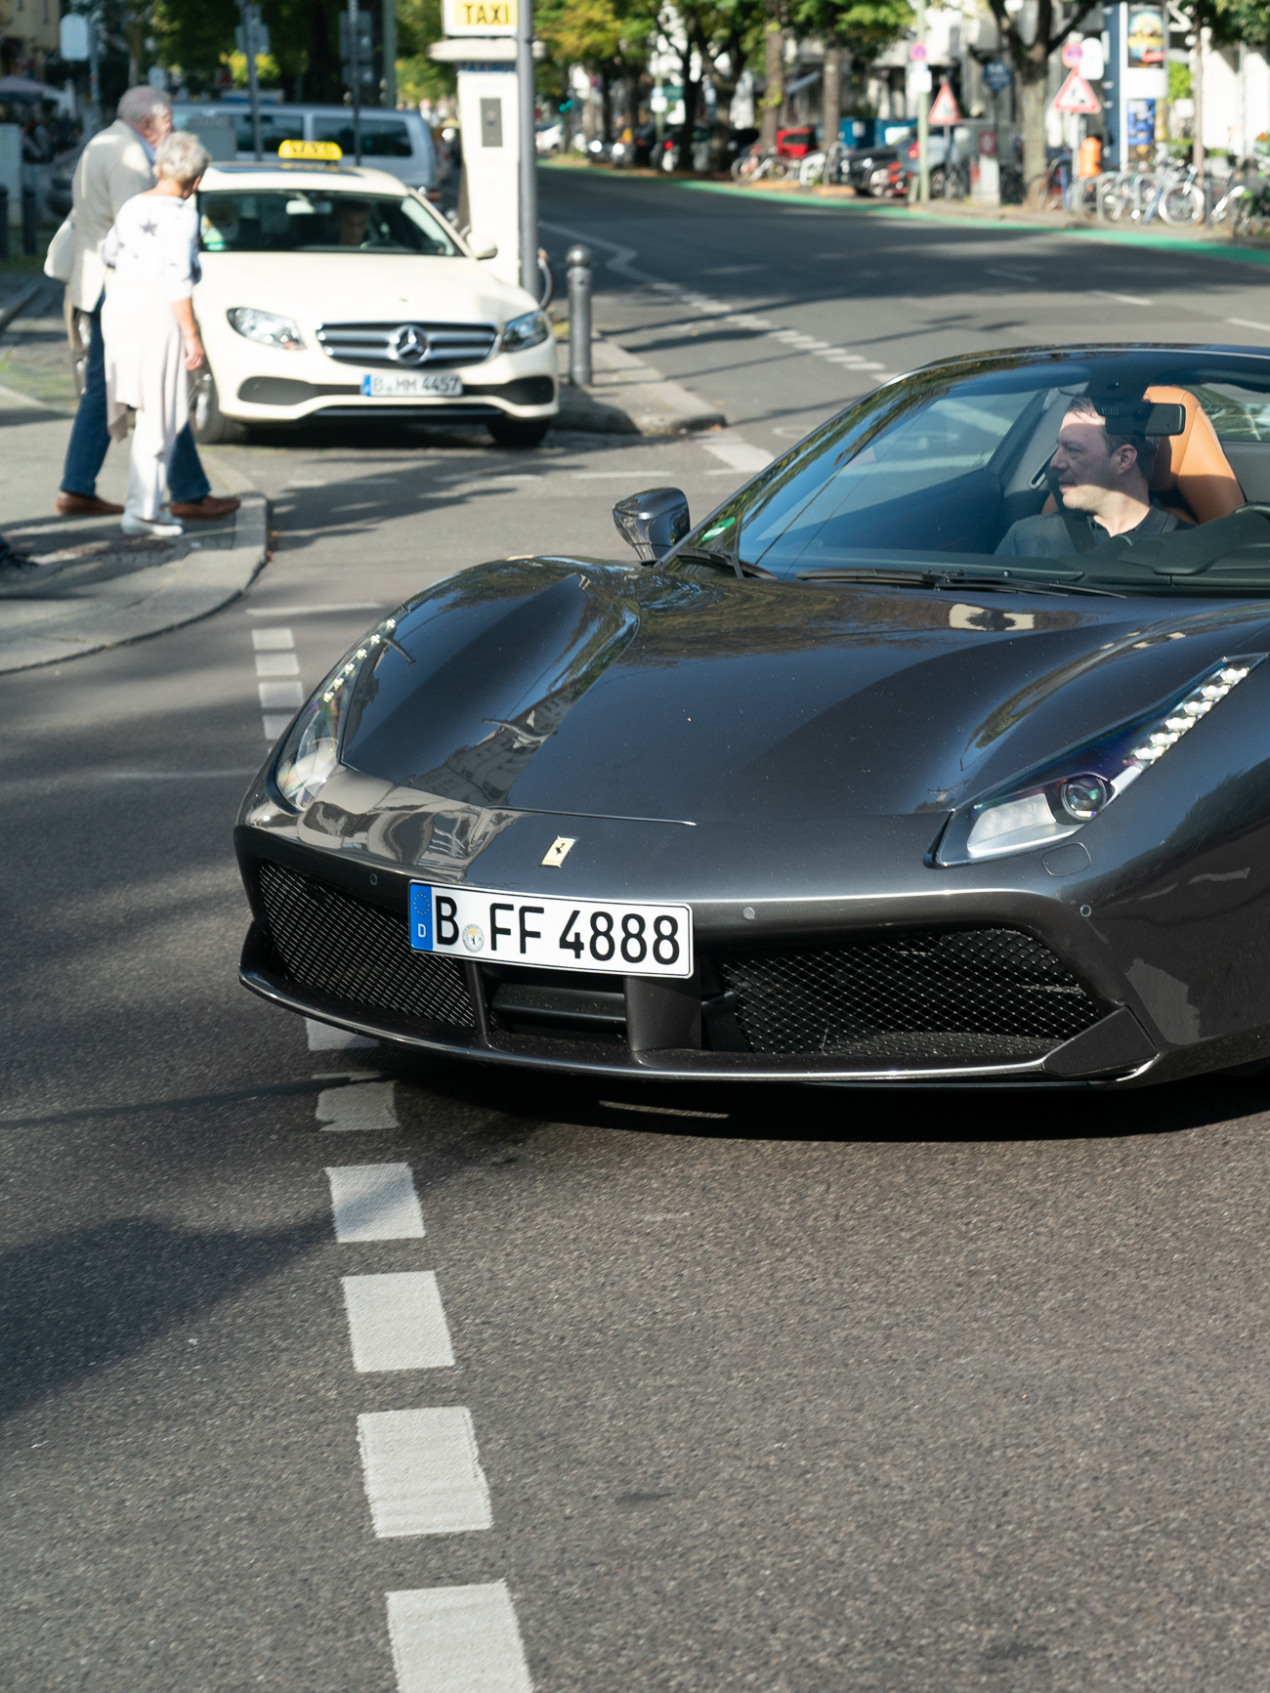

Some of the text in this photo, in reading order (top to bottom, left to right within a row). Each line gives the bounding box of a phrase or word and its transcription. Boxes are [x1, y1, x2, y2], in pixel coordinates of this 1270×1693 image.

[463, 4, 509, 24] TAXI
[374, 378, 384, 392] B
[418, 895, 680, 965] D B FF 4888
